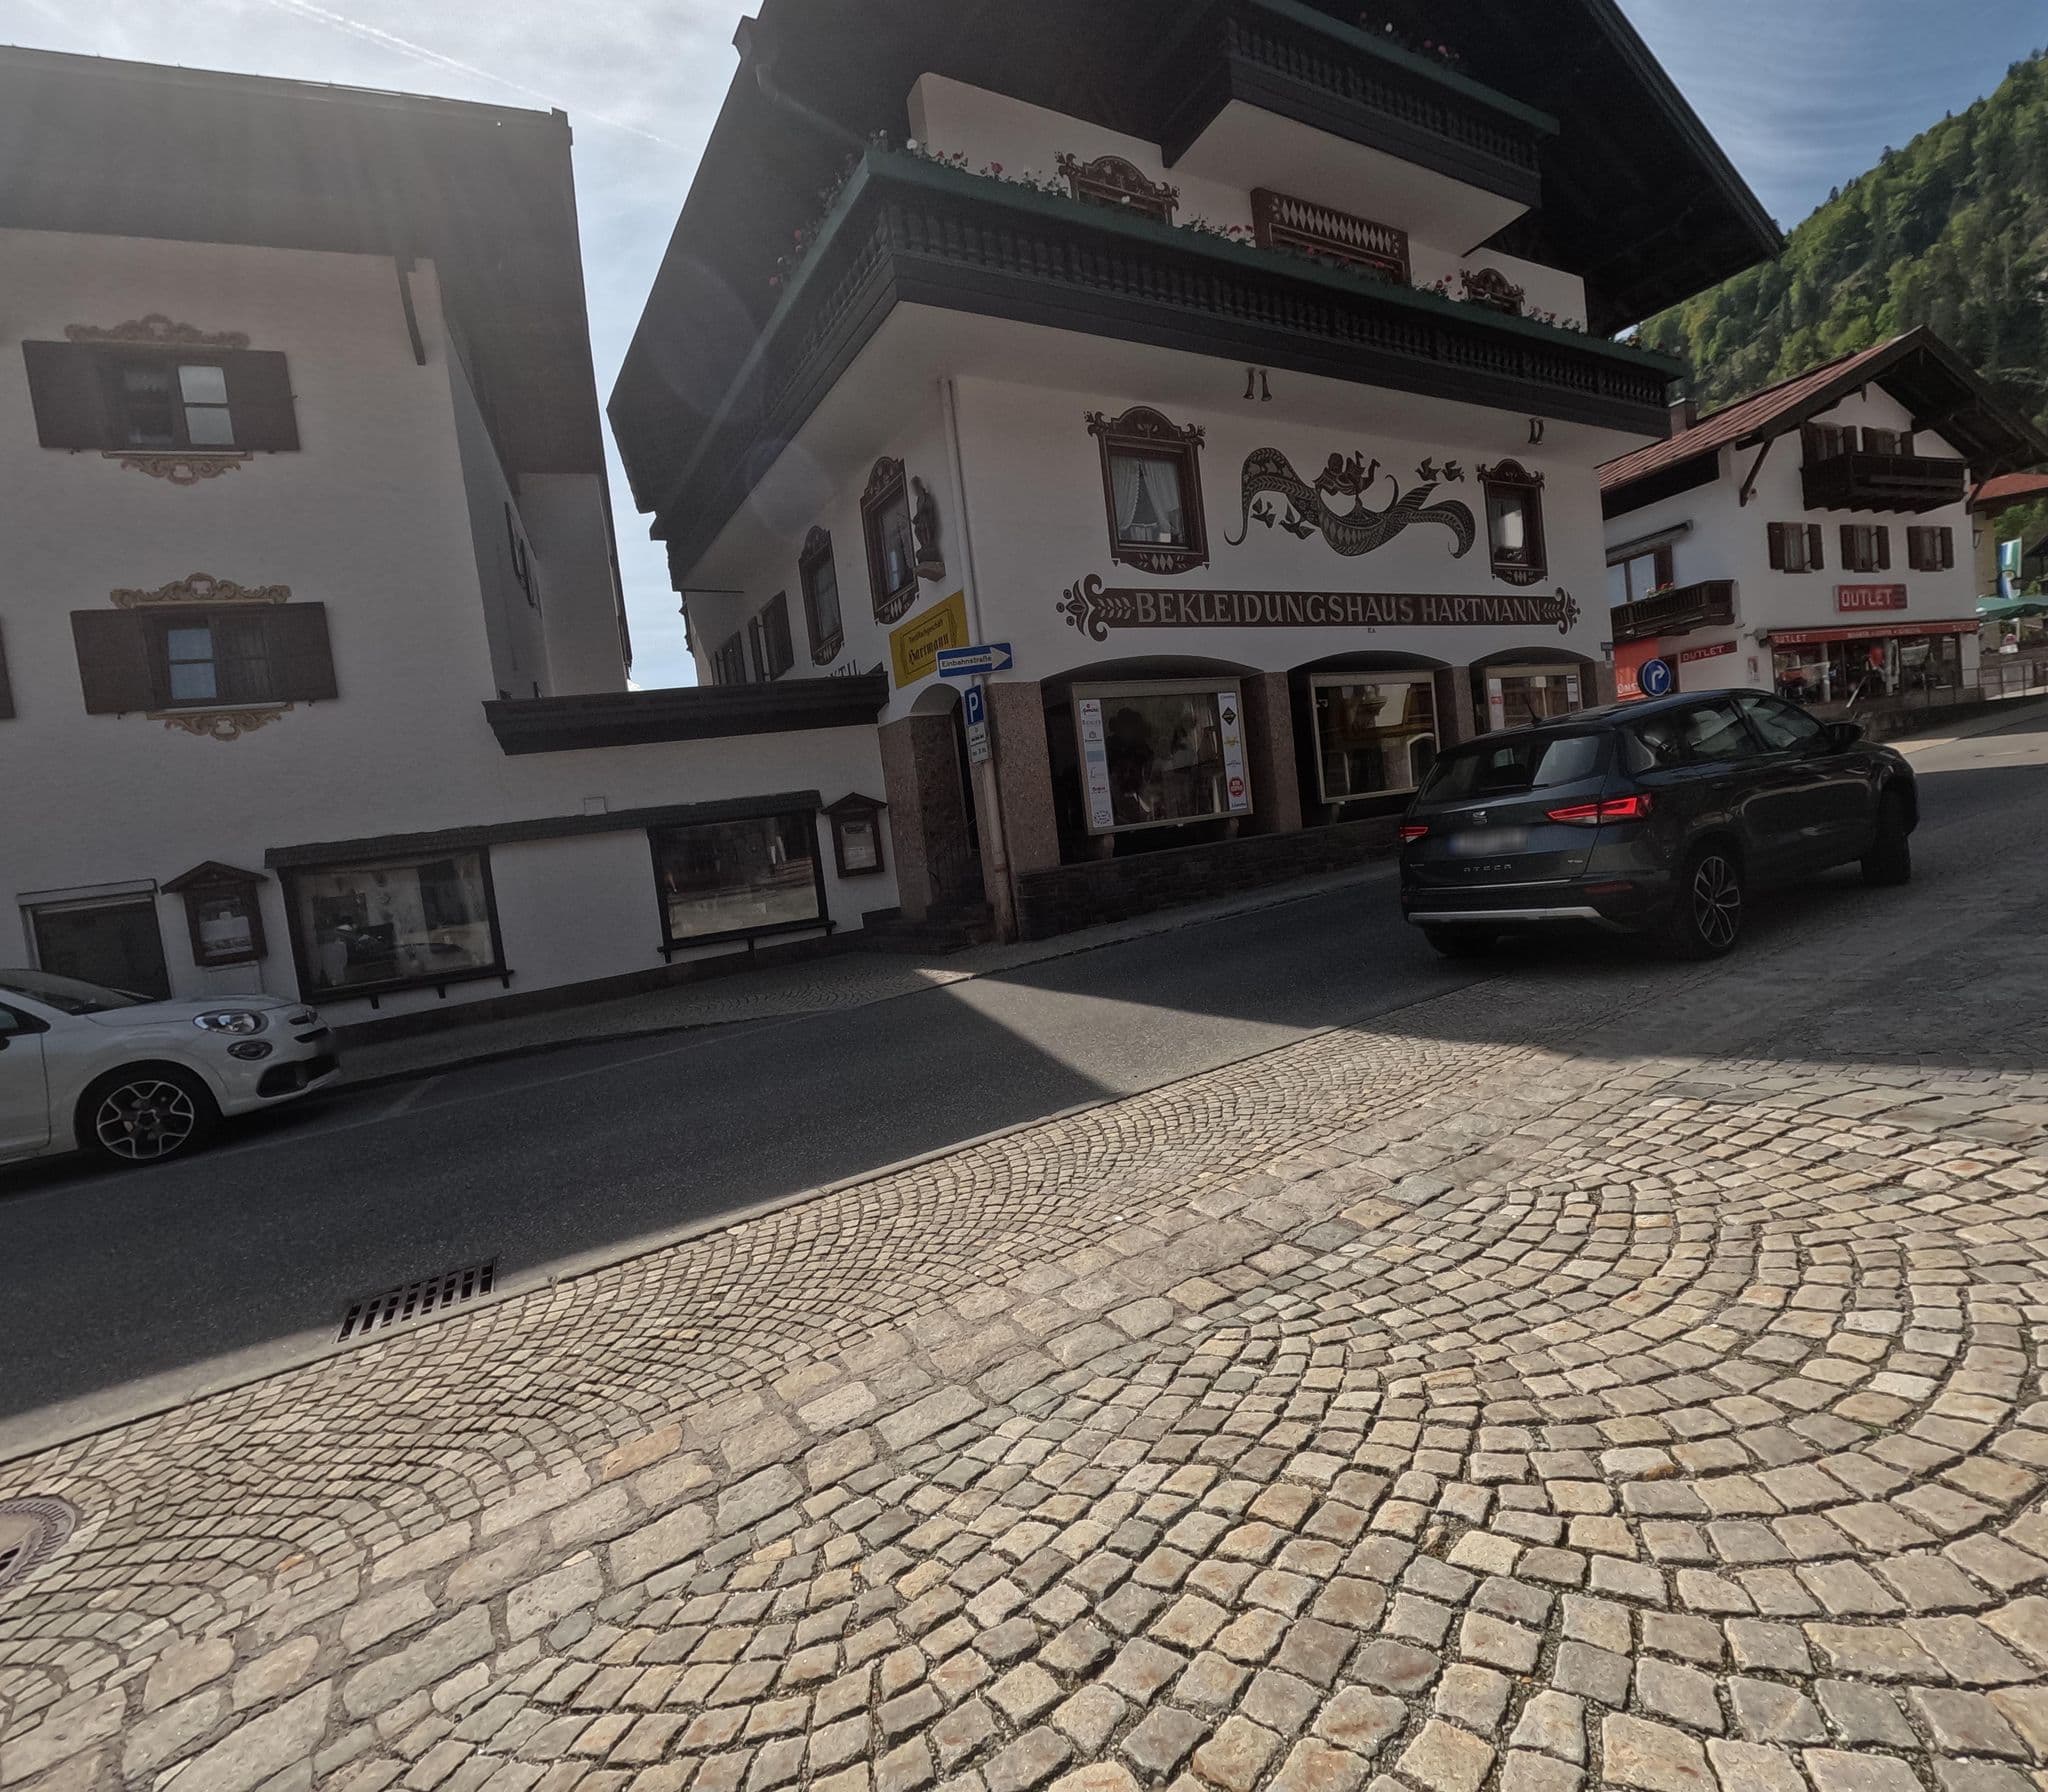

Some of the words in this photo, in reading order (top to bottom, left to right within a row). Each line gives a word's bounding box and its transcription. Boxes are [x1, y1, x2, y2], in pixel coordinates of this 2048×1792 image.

[1841, 588, 1892, 607] OUTLET
[1135, 591, 1415, 624] BEKLEIDUNGSHAUS
[1423, 596, 1543, 622] HARTMANN
[941, 656, 992, 668] Einbahnstraße
[1682, 645, 1725, 662] OUTLET
[968, 692, 979, 723] P
